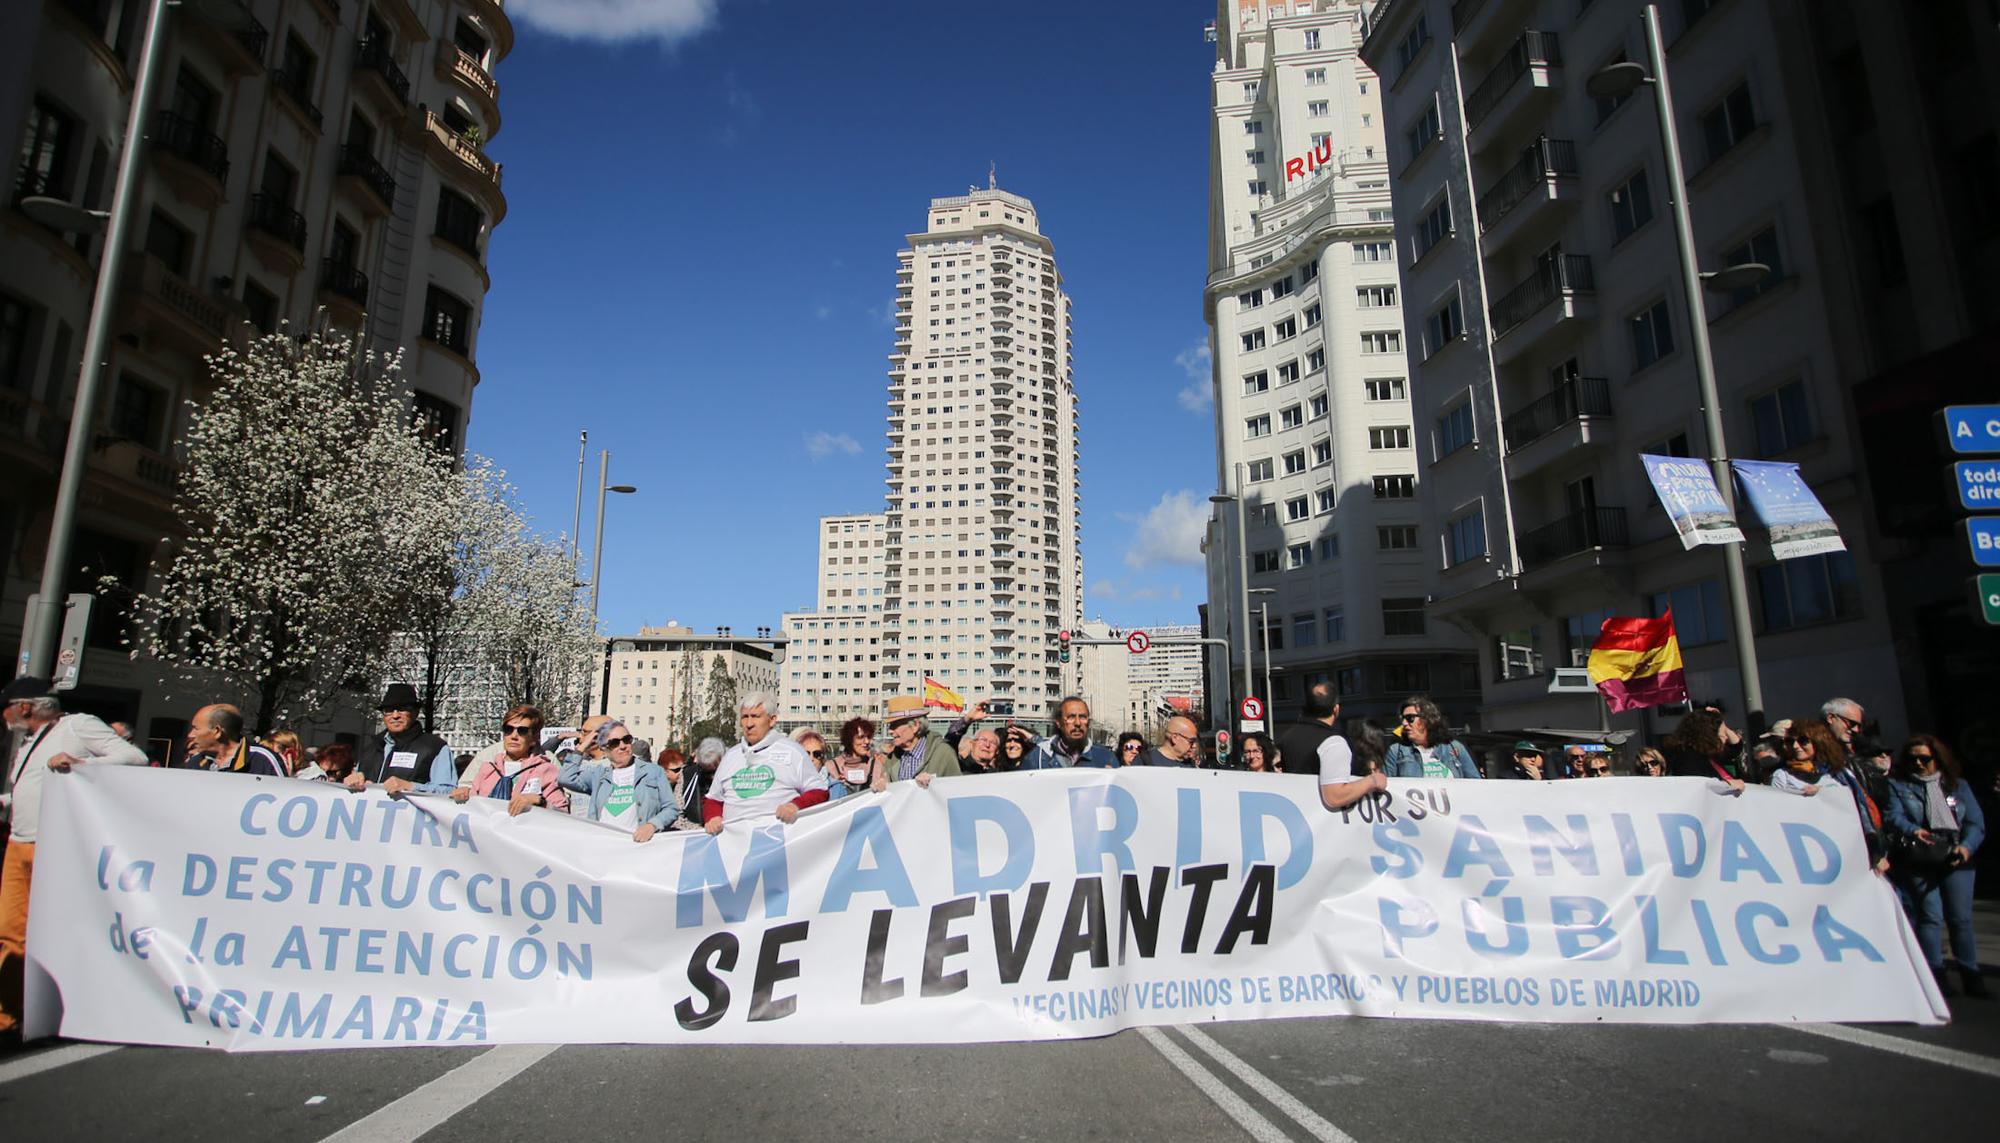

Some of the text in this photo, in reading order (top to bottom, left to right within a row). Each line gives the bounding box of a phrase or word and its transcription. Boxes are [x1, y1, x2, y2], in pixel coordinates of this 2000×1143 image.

[1286, 136, 1332, 182] RIU
[1956, 420, 1973, 437] A
[1963, 468, 2000, 483] tod
[239, 793, 479, 854] CONTRA
[1405, 788, 1451, 820] SU
[675, 784, 1313, 929] MADRID
[1370, 812, 1842, 886] SANIDAD
[97, 845, 602, 925] la DESTRUCCIÓN
[109, 911, 593, 981] de la ATENCIÓN
[674, 863, 1276, 1031] SE LEVANTA
[1379, 880, 1886, 966] PÚBLICA
[174, 984, 488, 1041] PRIMARIA
[1013, 973, 1701, 1023] VECINAS Y VECINOS DE BARRIOS Y PUEBLOS DE MADRID
